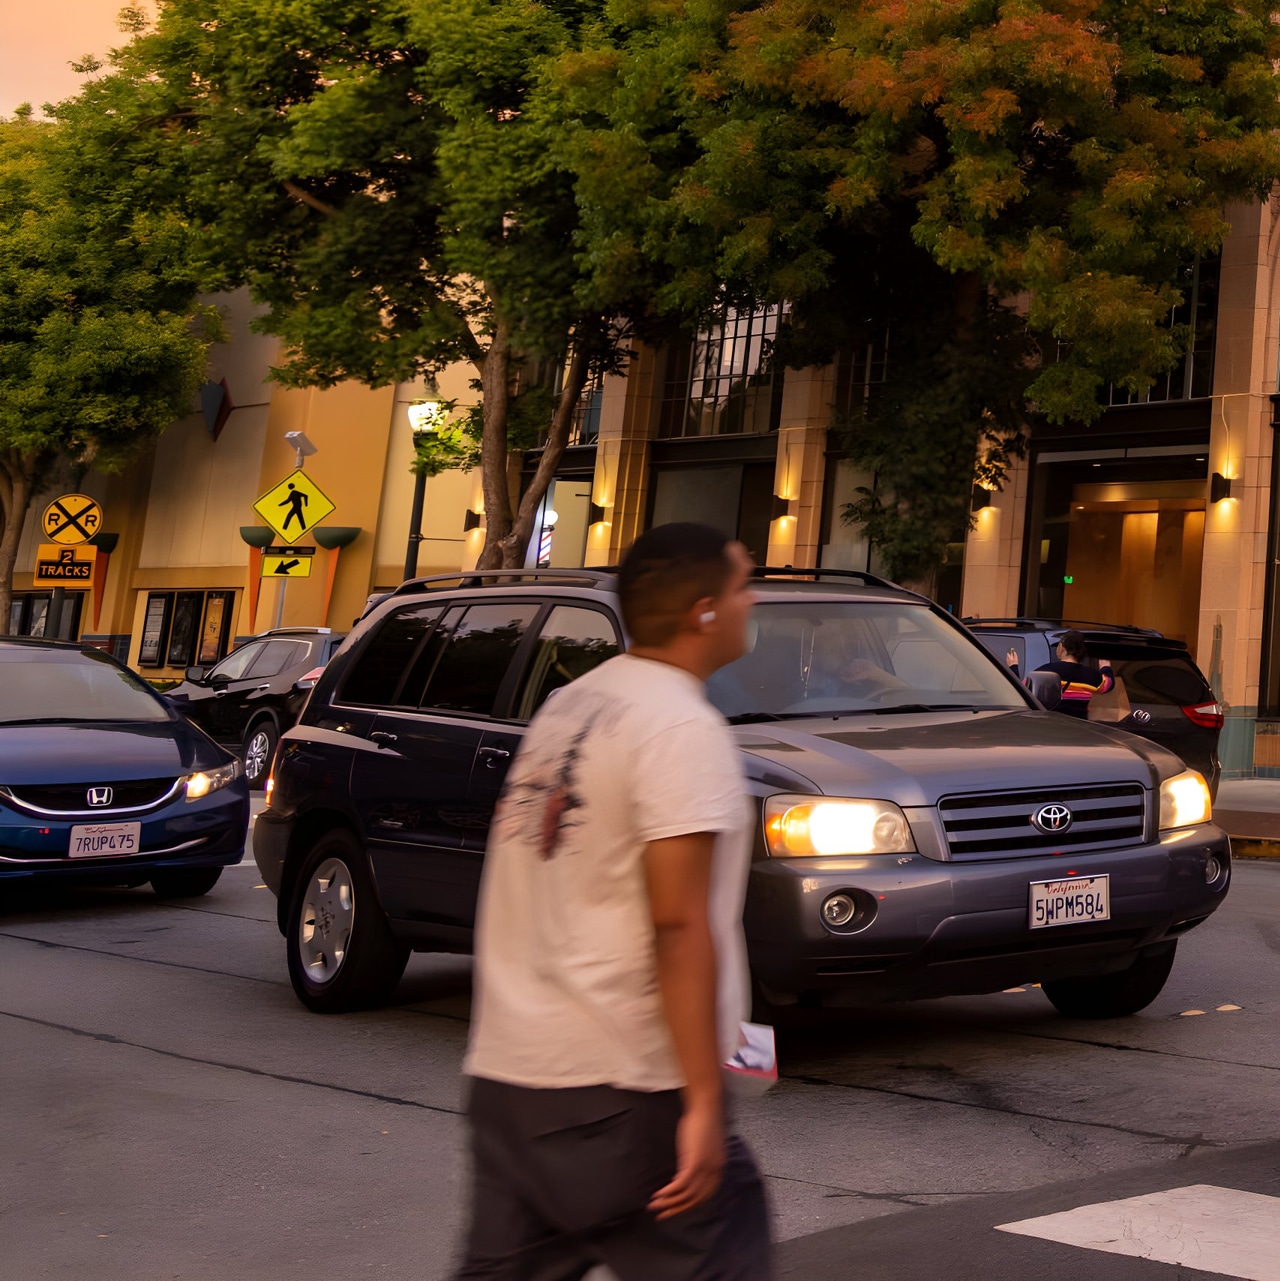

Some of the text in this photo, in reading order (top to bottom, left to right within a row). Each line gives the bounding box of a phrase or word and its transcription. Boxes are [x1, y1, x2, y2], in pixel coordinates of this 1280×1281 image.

[48, 513, 98, 527] R R
[62, 552, 72, 563] 2
[41, 565, 89, 577] TRACKS
[1046, 880, 1094, 896] California
[1035, 892, 1104, 921] 5WPM584
